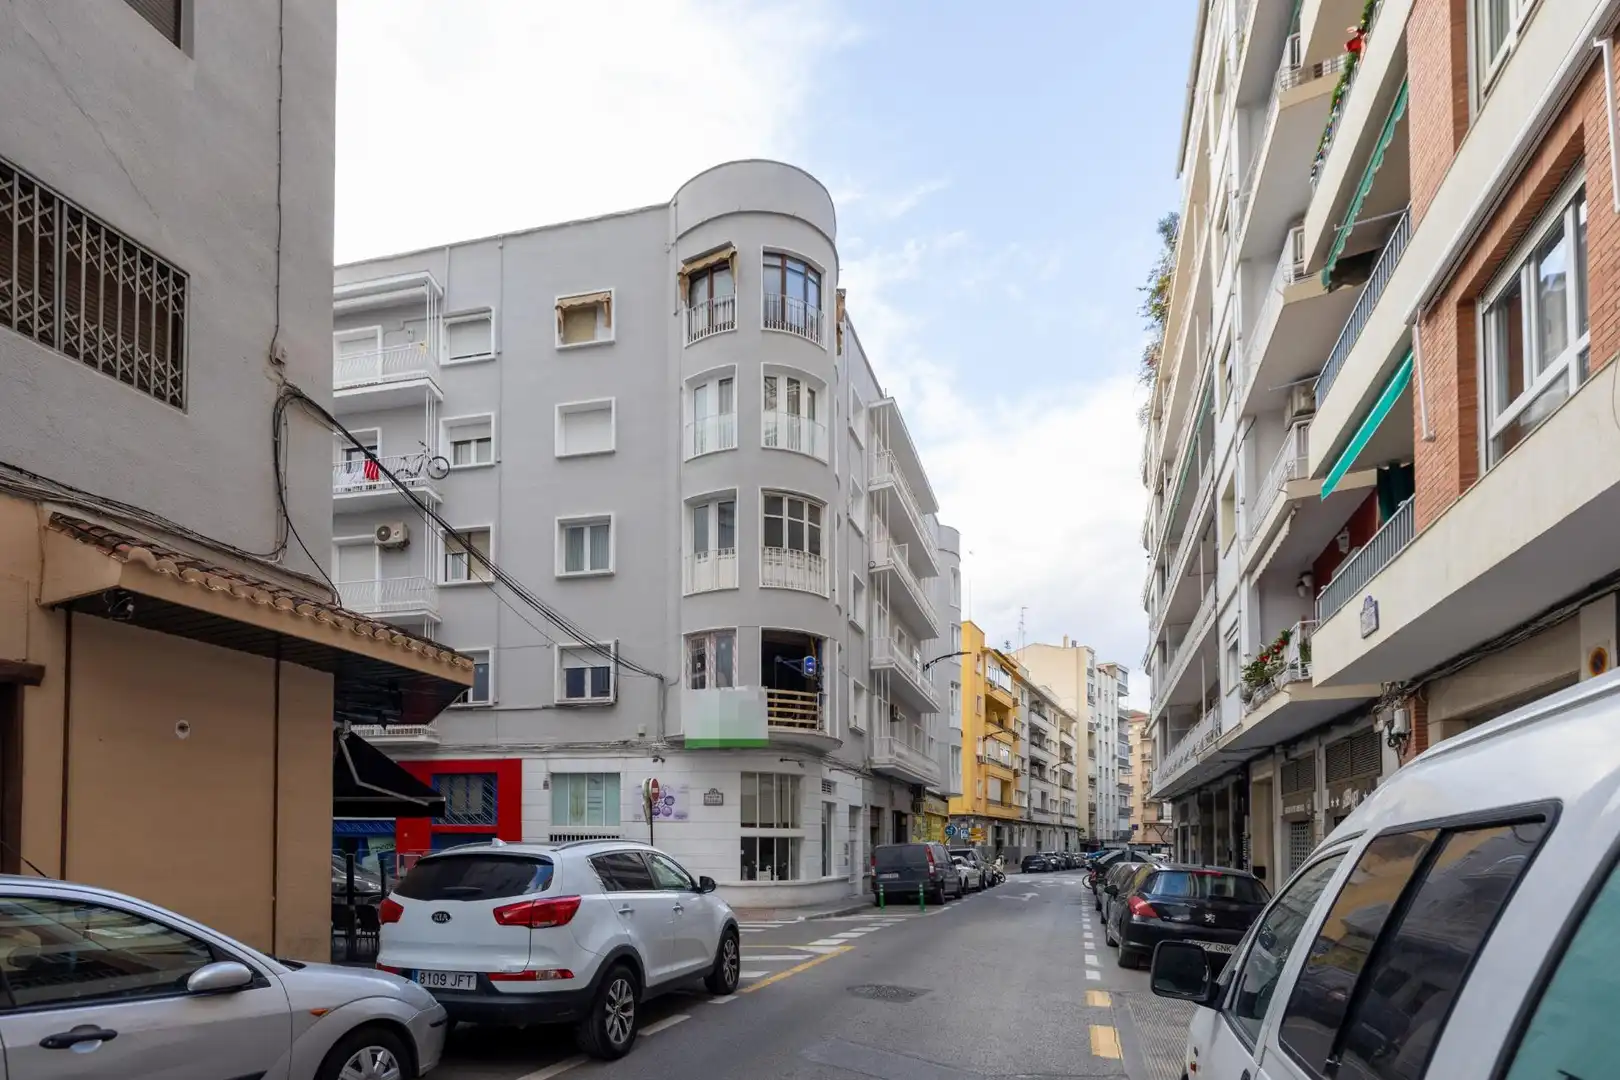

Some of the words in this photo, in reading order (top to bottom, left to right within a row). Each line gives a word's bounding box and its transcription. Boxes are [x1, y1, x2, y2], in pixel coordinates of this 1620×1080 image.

[1216, 944, 1232, 953] GNK
[419, 972, 447, 986] 8109
[450, 974, 474, 988] JFT
